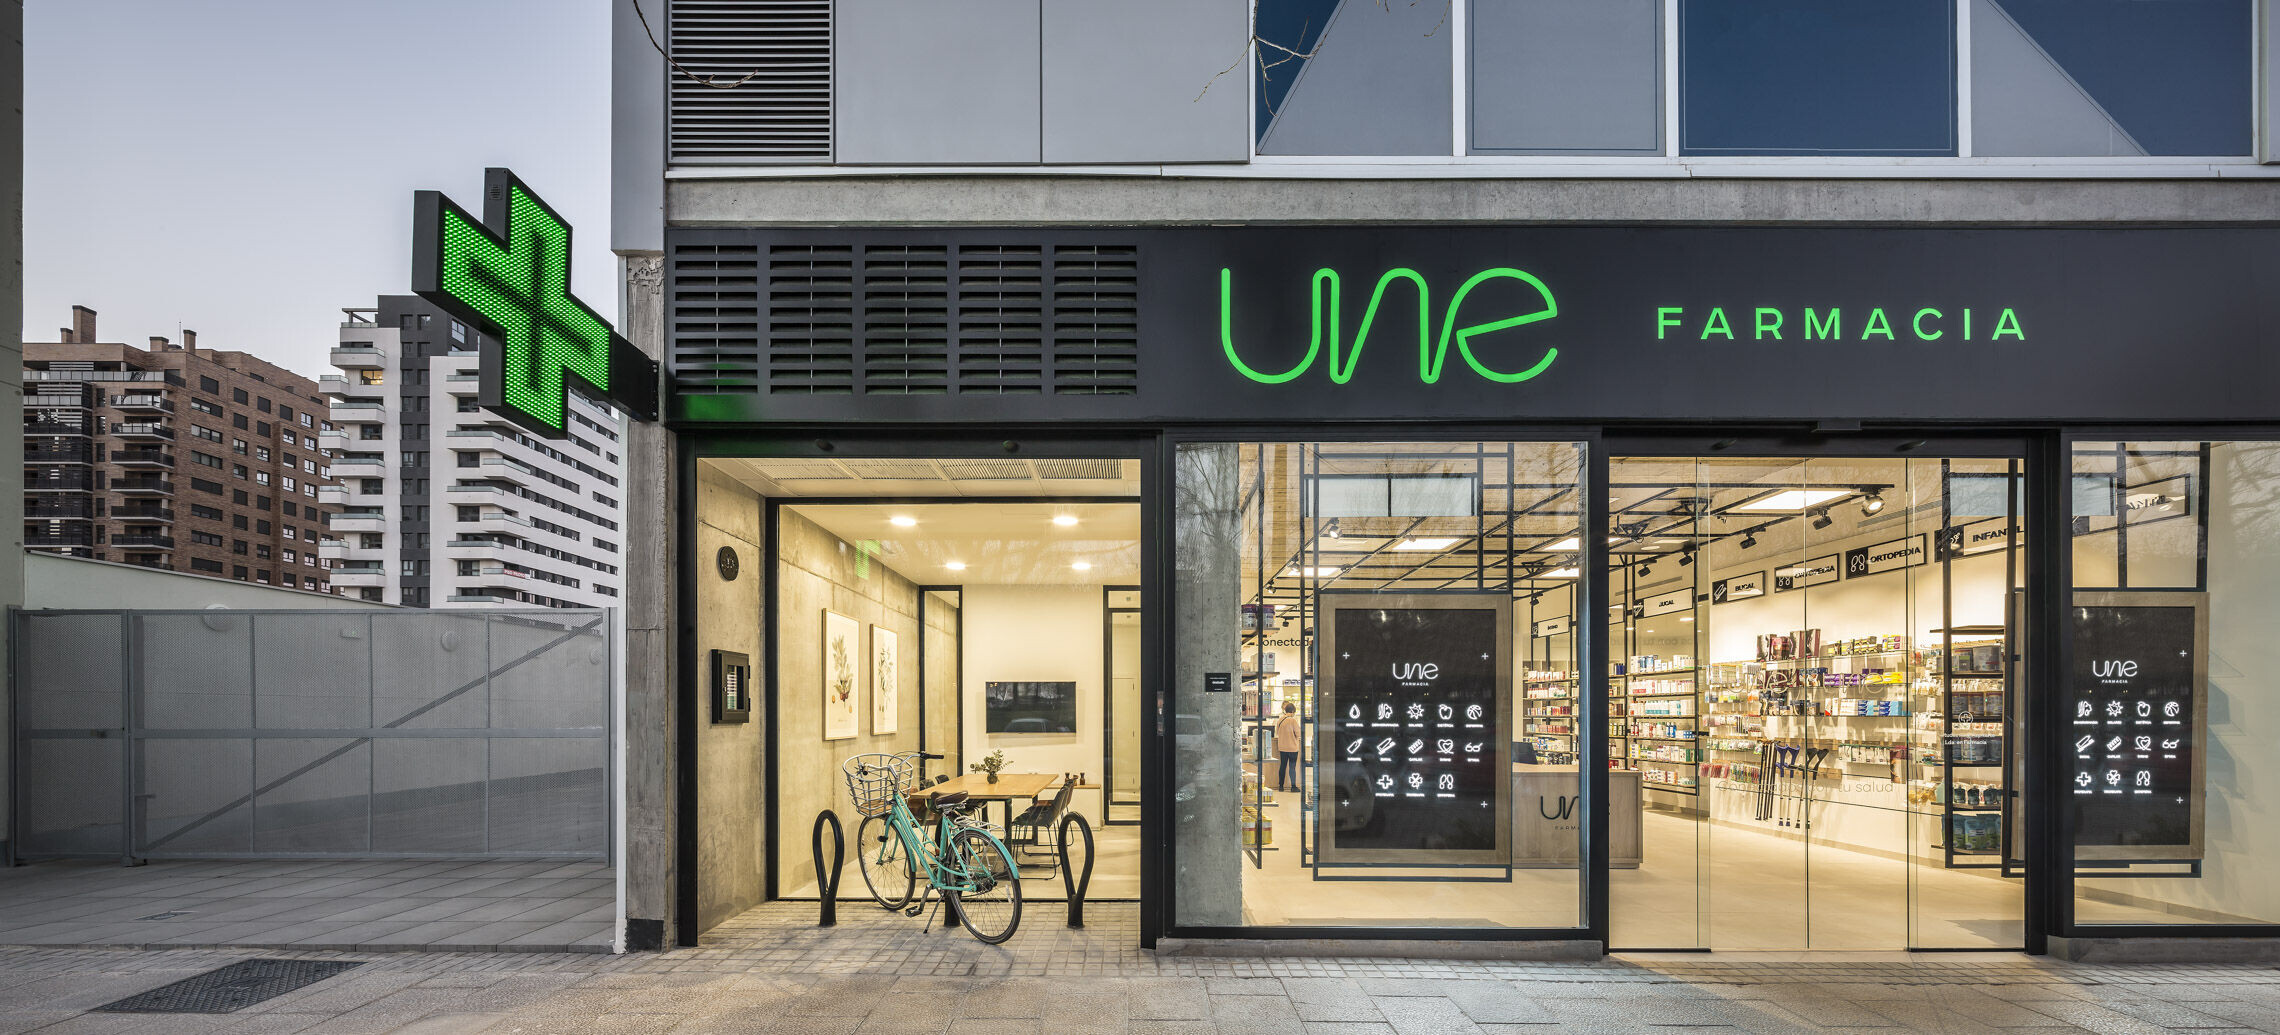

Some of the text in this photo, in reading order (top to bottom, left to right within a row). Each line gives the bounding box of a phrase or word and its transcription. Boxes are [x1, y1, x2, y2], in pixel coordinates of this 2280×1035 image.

[1221, 267, 2025, 384] une FARMACIA
[1972, 525, 2025, 543] INFANL
[1870, 546, 1922, 563] ORTOPEDIA
[1735, 582, 1755, 592] BUCAL
[1262, 637, 1310, 647] onectad
[1392, 662, 1439, 680] une
[2092, 660, 2138, 678] une
[1855, 780, 1894, 793] salud
[1541, 795, 1580, 820] un
